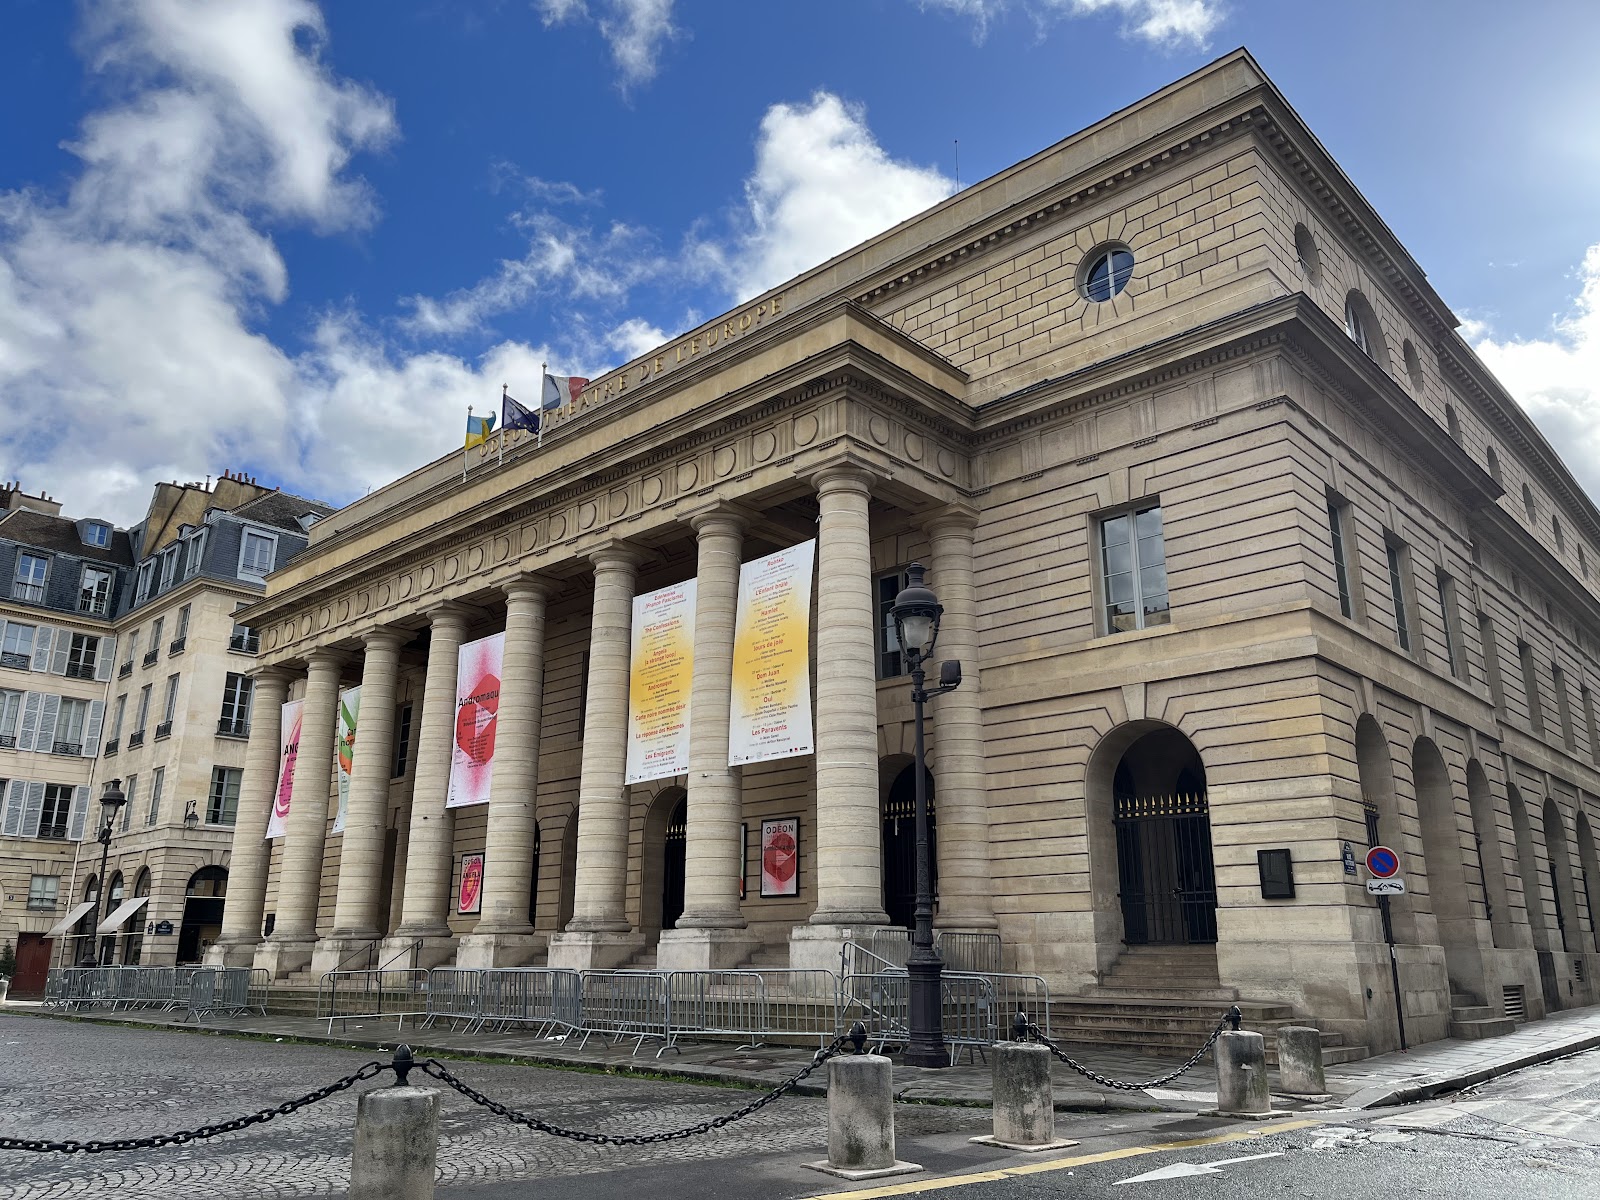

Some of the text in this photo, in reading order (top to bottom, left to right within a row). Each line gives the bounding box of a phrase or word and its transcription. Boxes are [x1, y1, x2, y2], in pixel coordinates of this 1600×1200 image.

[639, 356, 664, 381] DE
[676, 295, 784, 364] L'EUROPE
[760, 607, 779, 616] Hamlet
[757, 672, 767, 680] Dom
[761, 724, 788, 734] Paravents
